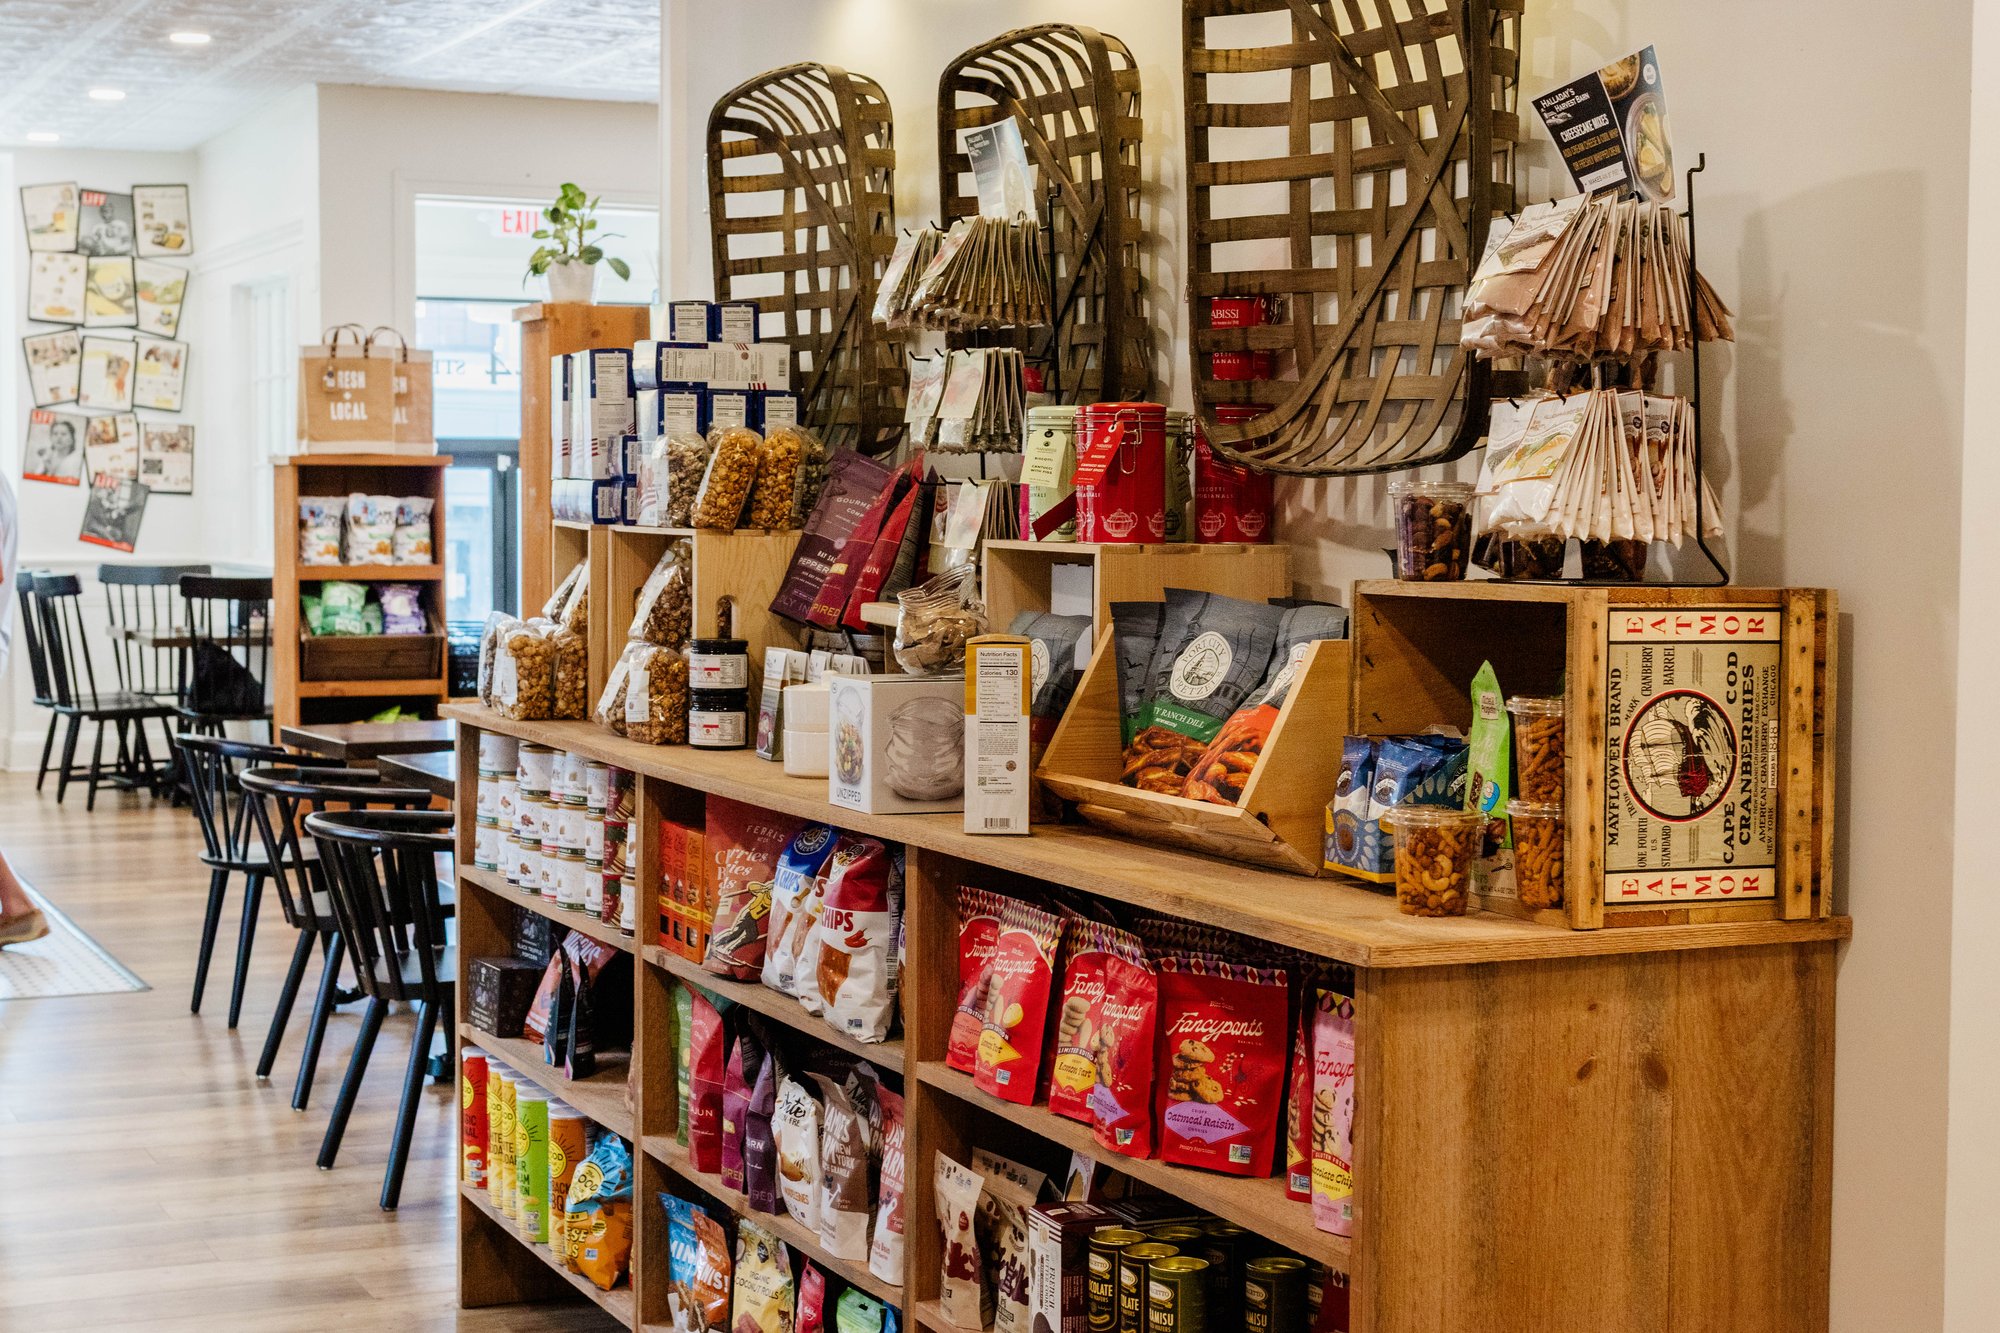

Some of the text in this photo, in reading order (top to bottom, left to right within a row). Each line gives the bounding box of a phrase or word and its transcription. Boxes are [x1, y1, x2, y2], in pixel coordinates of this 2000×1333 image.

[1574, 92, 1590, 104] BARN
[1560, 113, 1610, 143] CHEESECAKE MIXES
[325, 370, 366, 389] RESH
[330, 401, 368, 421] LOCAL
[799, 557, 830, 575] PEPPER
[1627, 614, 1764, 635] EATMOR
[1641, 646, 1653, 697] CRANBERRY
[1663, 646, 1675, 685] BARREL
[1161, 708, 1187, 724] RANCH
[1187, 715, 1205, 729] DILL
[1769, 726, 1778, 750] 848
[1608, 668, 1622, 845] MAYFLOWER BRAND
[1623, 695, 1640, 817] TRADE MARK
[1723, 651, 1738, 864] CAPE COD
[1739, 664, 1754, 845] CRANBERRIES
[1759, 666, 1769, 843] AMERICAN CRANBERRY EXCHANGE
[836, 786, 862, 803] UNZIPPED
[746, 824, 786, 843] FERRIS
[1637, 817, 1648, 868] ONE FOURTH
[1661, 825, 1672, 867] STANDARD
[1622, 875, 1760, 897] EATMOR
[1166, 1012, 1264, 1042] Fancypants
[1058, 1061, 1092, 1079] Lemon Tart
[1167, 1111, 1235, 1131] Oatmeal Raisin
[835, 1155, 857, 1170] YORK
[1315, 1151, 1332, 1162] GLUTEN
